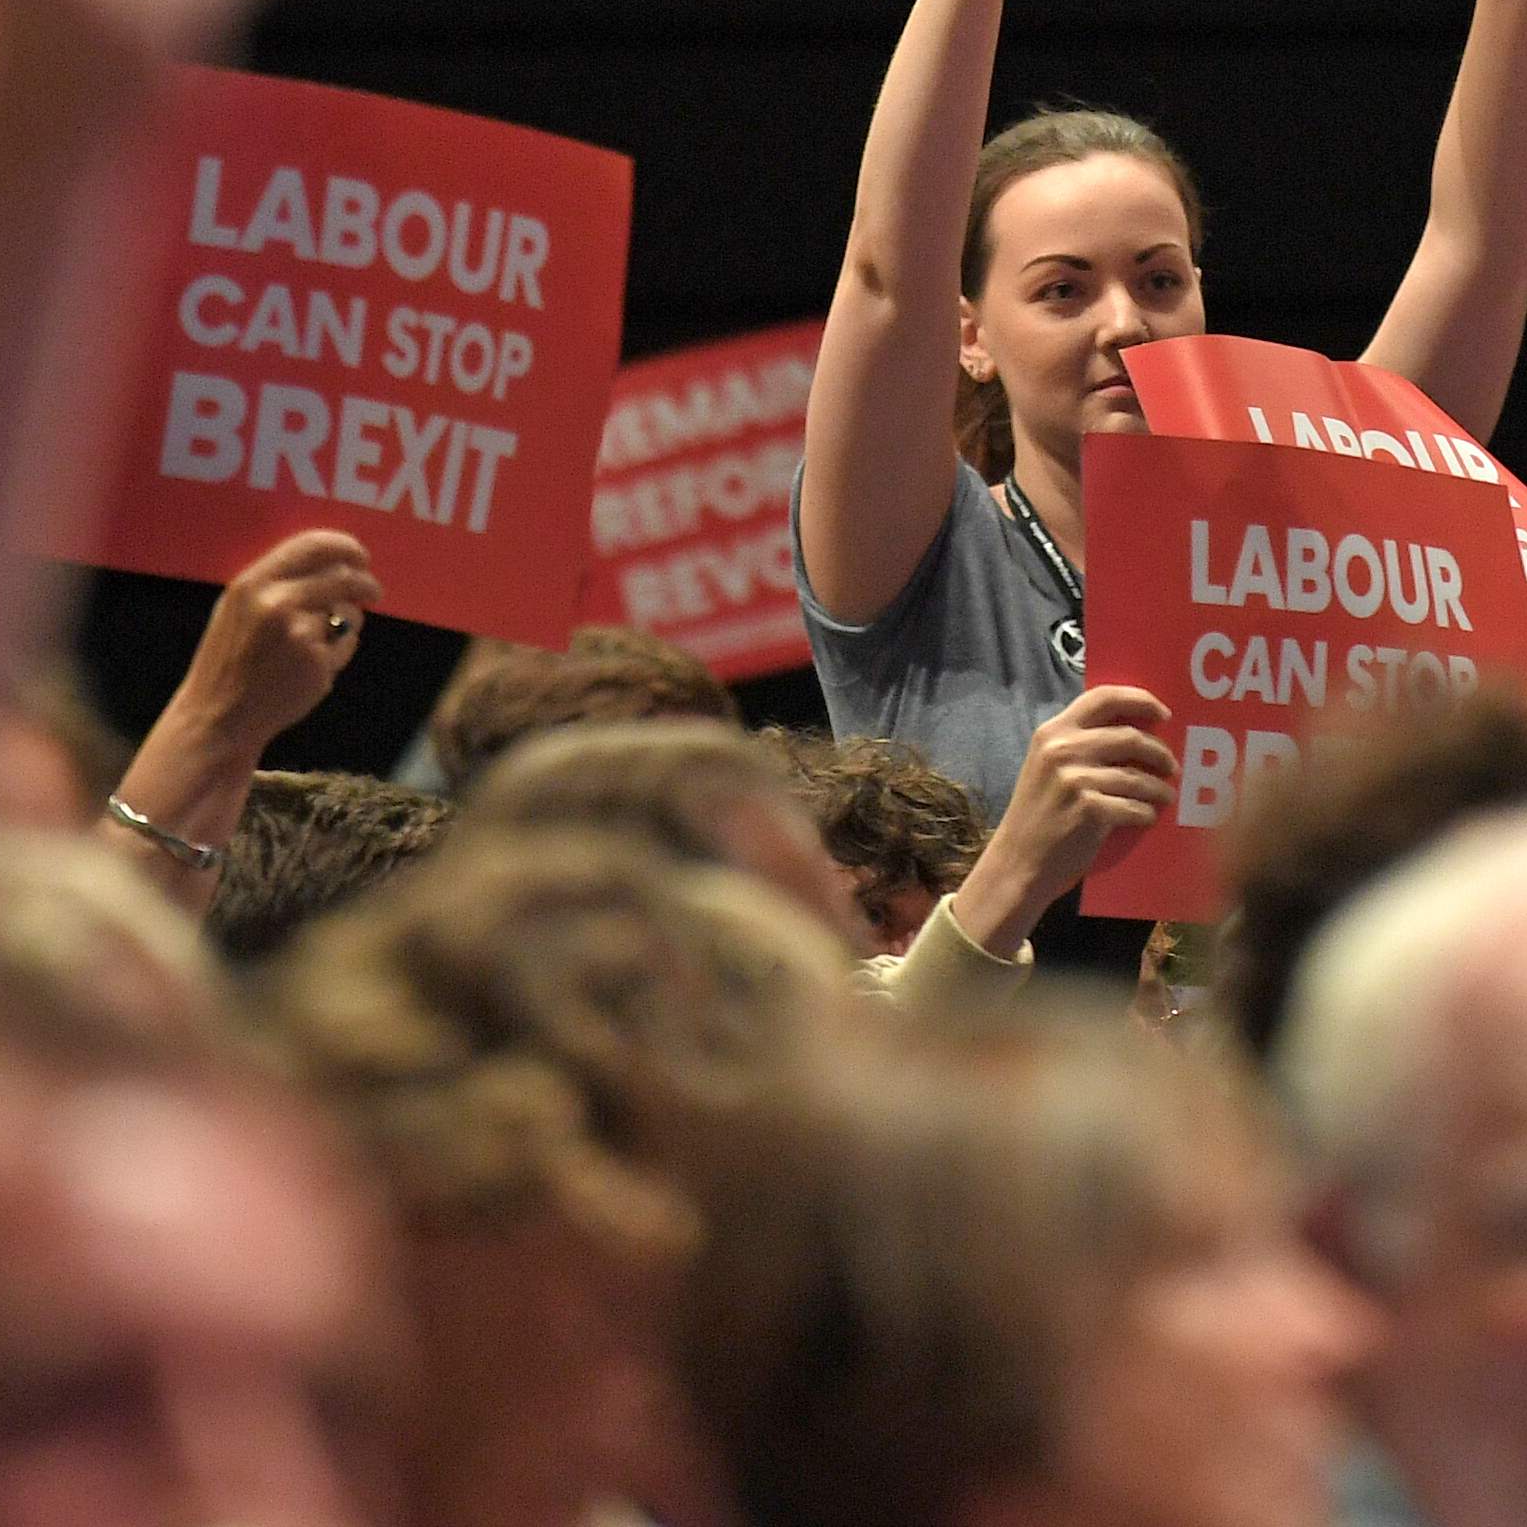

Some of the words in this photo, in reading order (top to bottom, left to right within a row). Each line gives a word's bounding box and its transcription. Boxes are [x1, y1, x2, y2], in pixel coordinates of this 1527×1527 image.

[188, 156, 551, 309] LABOUR
[177, 275, 367, 367] CAN
[382, 305, 534, 401] STOP
[159, 371, 517, 534] BREXIT
[1191, 519, 1473, 632] LABOUR
[1190, 631, 1328, 708] CAN
